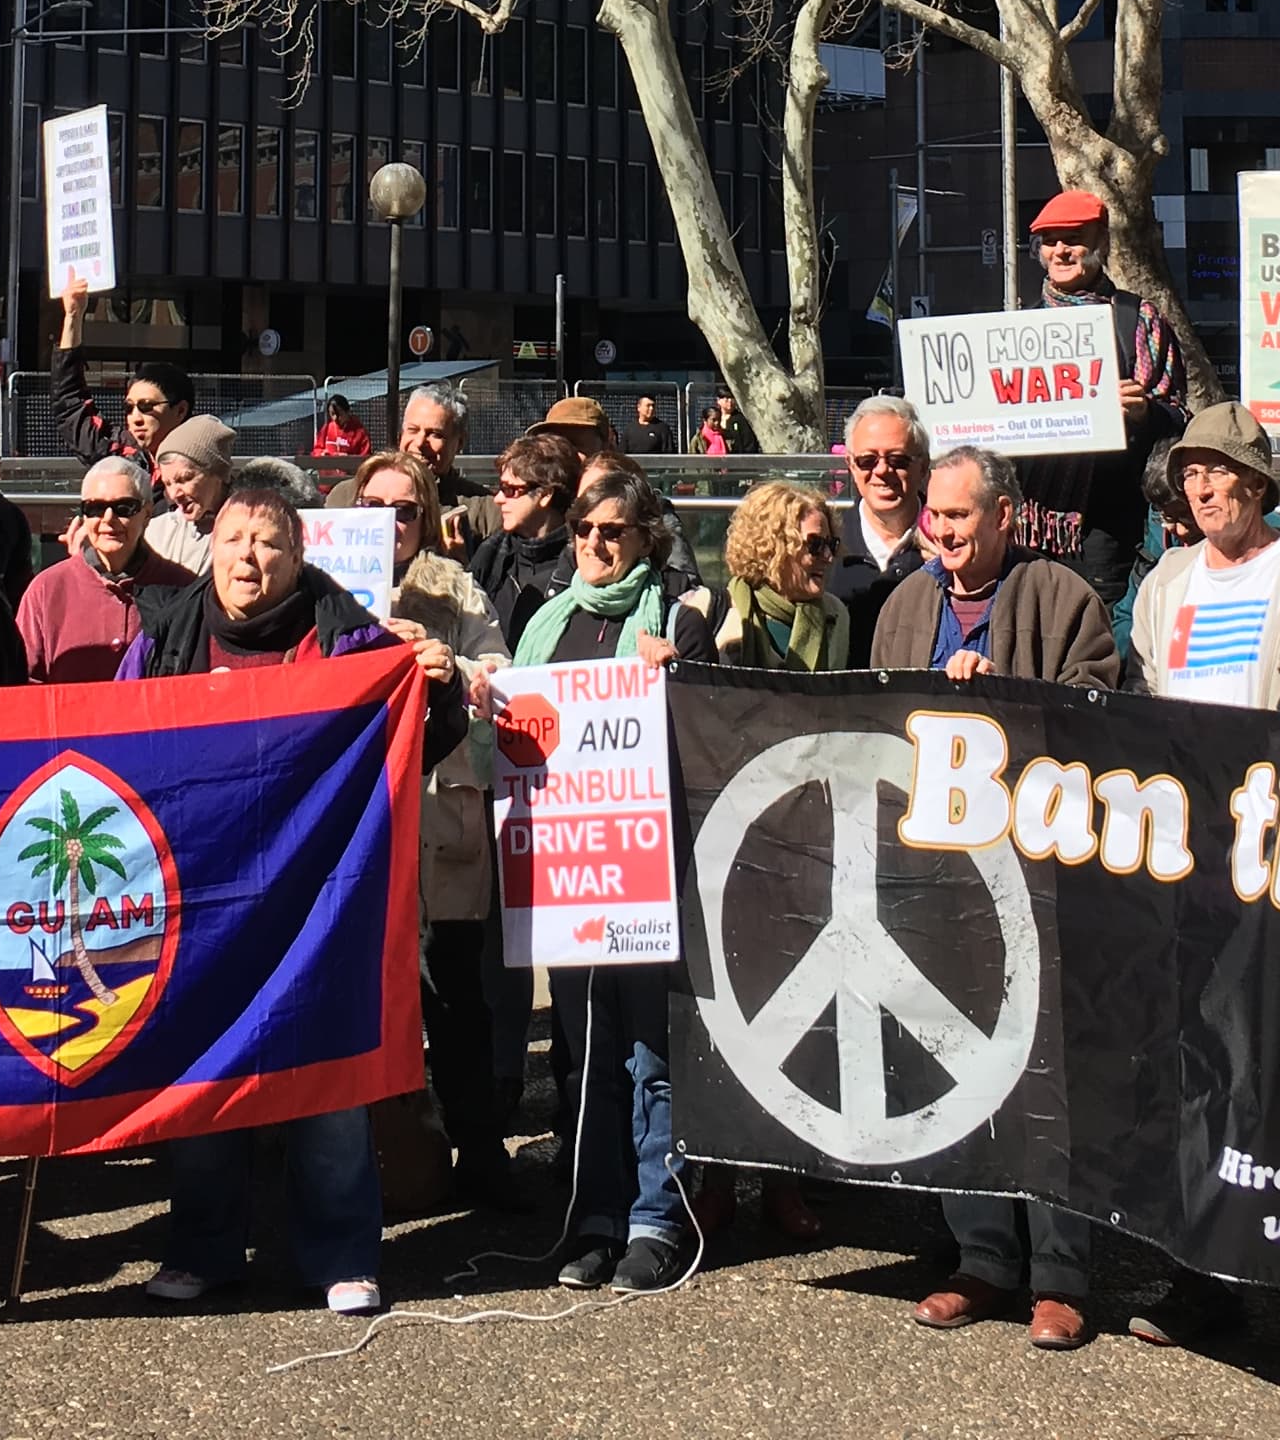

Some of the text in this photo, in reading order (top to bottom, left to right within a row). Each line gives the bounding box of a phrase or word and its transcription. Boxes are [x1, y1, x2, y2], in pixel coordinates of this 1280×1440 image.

[921, 322, 1095, 404] NO MORE
[989, 358, 1103, 405] WAR!
[935, 425, 949, 436] US
[952, 423, 995, 435] Marines
[1008, 419, 1026, 431] Out
[1045, 414, 1089, 428] Darwin!
[342, 527, 384, 546] THE
[550, 662, 661, 703] TRUMP
[502, 716, 641, 752] STOP AND
[503, 767, 665, 809] TURNBULL
[897, 710, 1194, 884] Ban
[510, 817, 660, 856] DRIVE TO
[547, 864, 625, 898] WAR
[606, 918, 672, 940] Socialist
[608, 937, 671, 955] Alliance
